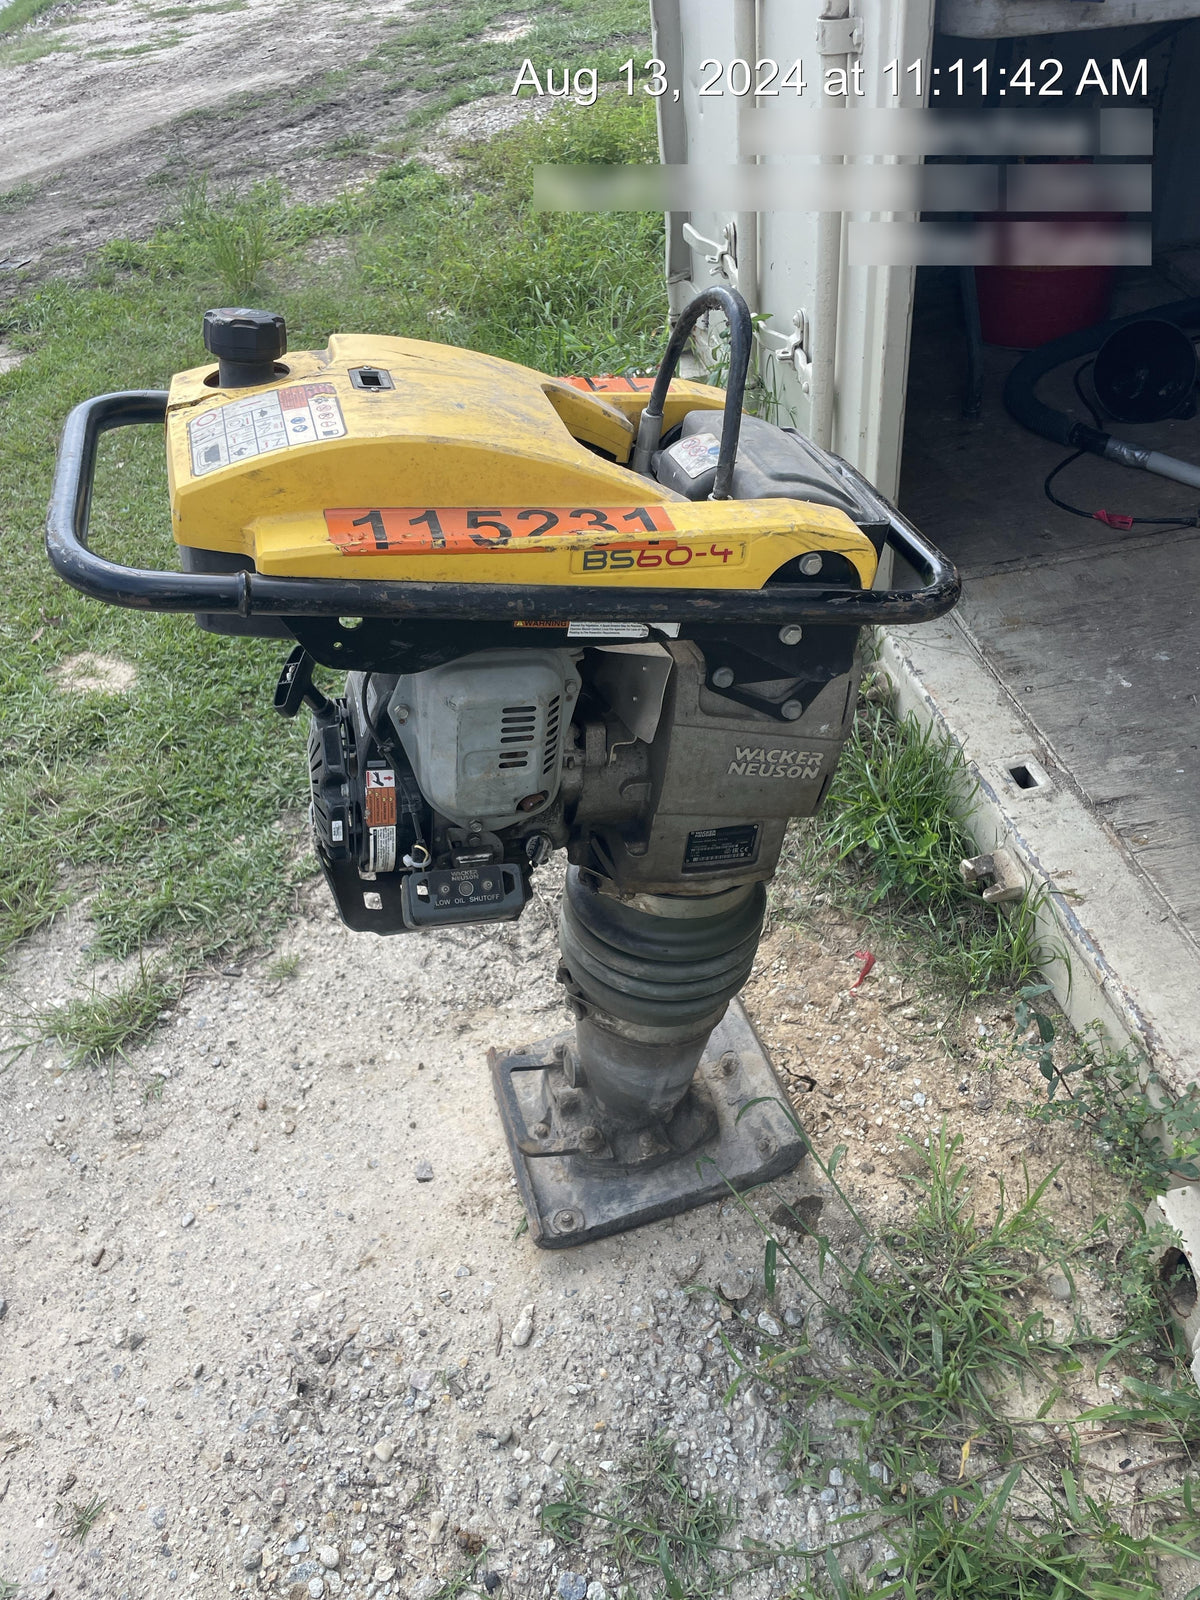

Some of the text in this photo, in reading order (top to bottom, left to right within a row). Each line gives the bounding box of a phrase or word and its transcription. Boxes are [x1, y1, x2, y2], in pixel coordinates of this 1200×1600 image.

[352, 507, 659, 550] 115231
[583, 543, 733, 571] BS60-4
[735, 746, 824, 766] WACKER
[727, 761, 820, 779] NEUSON
[435, 899, 451, 907] LOW
[469, 893, 500, 903] SHUTOFF
